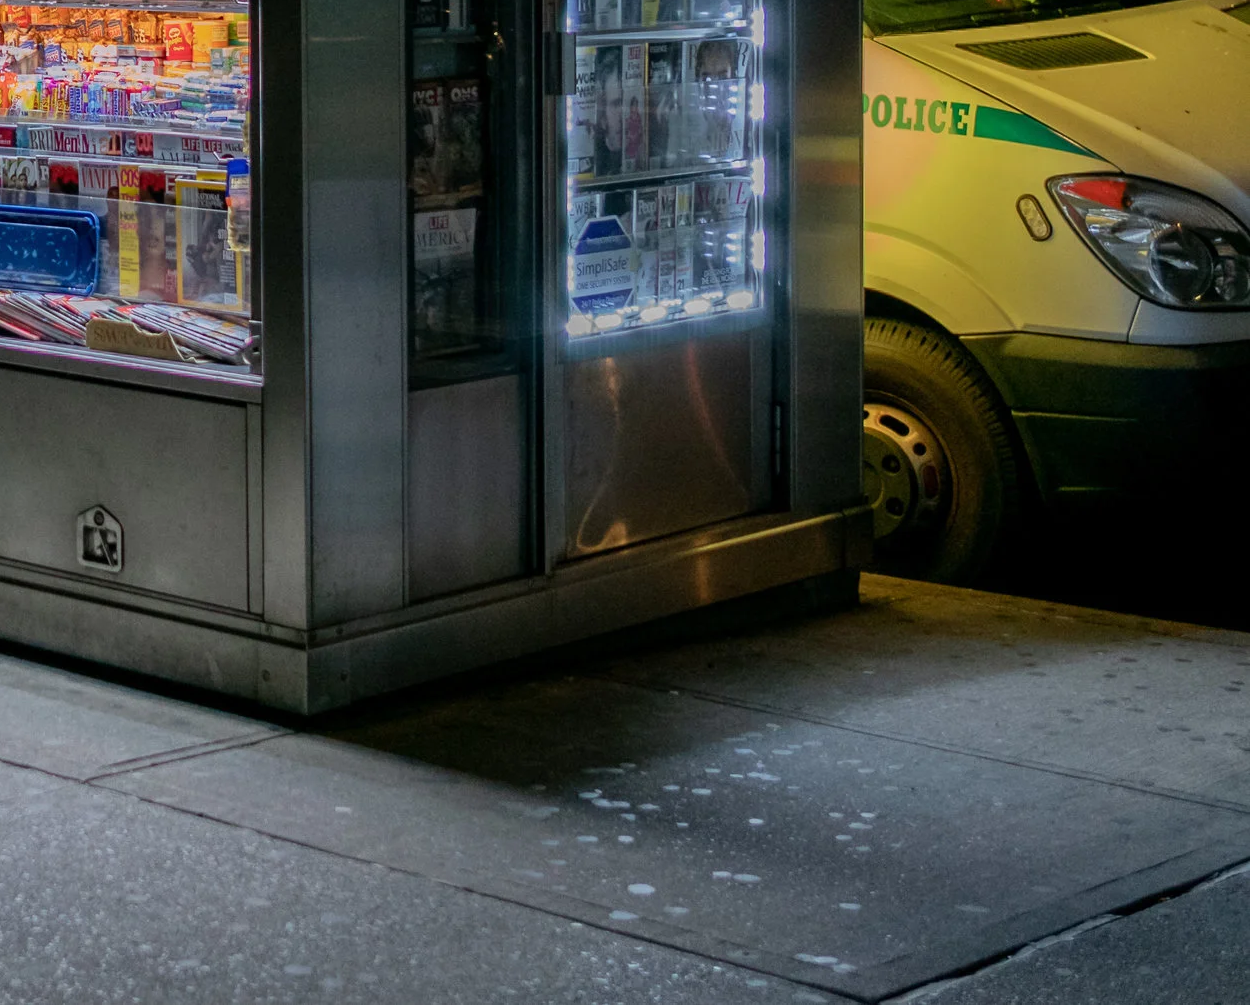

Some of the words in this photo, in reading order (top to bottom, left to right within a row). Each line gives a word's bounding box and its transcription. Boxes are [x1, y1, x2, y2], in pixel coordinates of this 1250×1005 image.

[182, 138, 200, 151] LIFE
[203, 139, 222, 153] LIFE
[82, 168, 119, 188] VANITY
[576, 258, 627, 277] SimpliSafe
[613, 275, 631, 286] SYSTEM
